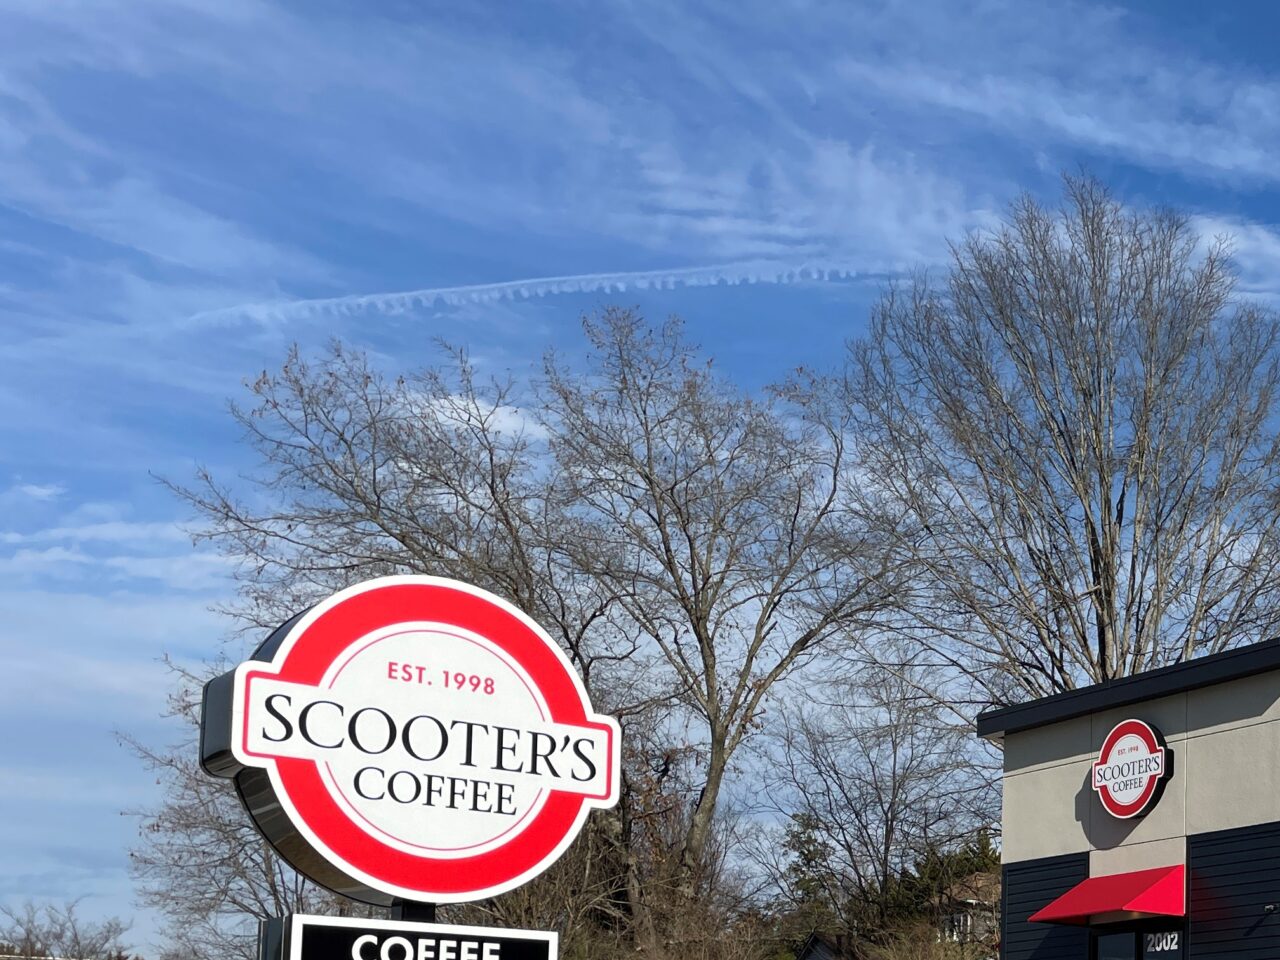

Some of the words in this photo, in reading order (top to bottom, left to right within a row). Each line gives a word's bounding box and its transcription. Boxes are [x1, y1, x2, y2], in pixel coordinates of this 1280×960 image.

[387, 661, 432, 686] EST.
[443, 670, 495, 695] 1998
[261, 693, 597, 783] SCOOTER'S
[1097, 756, 1160, 783] SCOOTER'S
[353, 766, 518, 817] COFFEE
[1112, 777, 1144, 793] COFFEE
[1146, 931, 1178, 952] 2002
